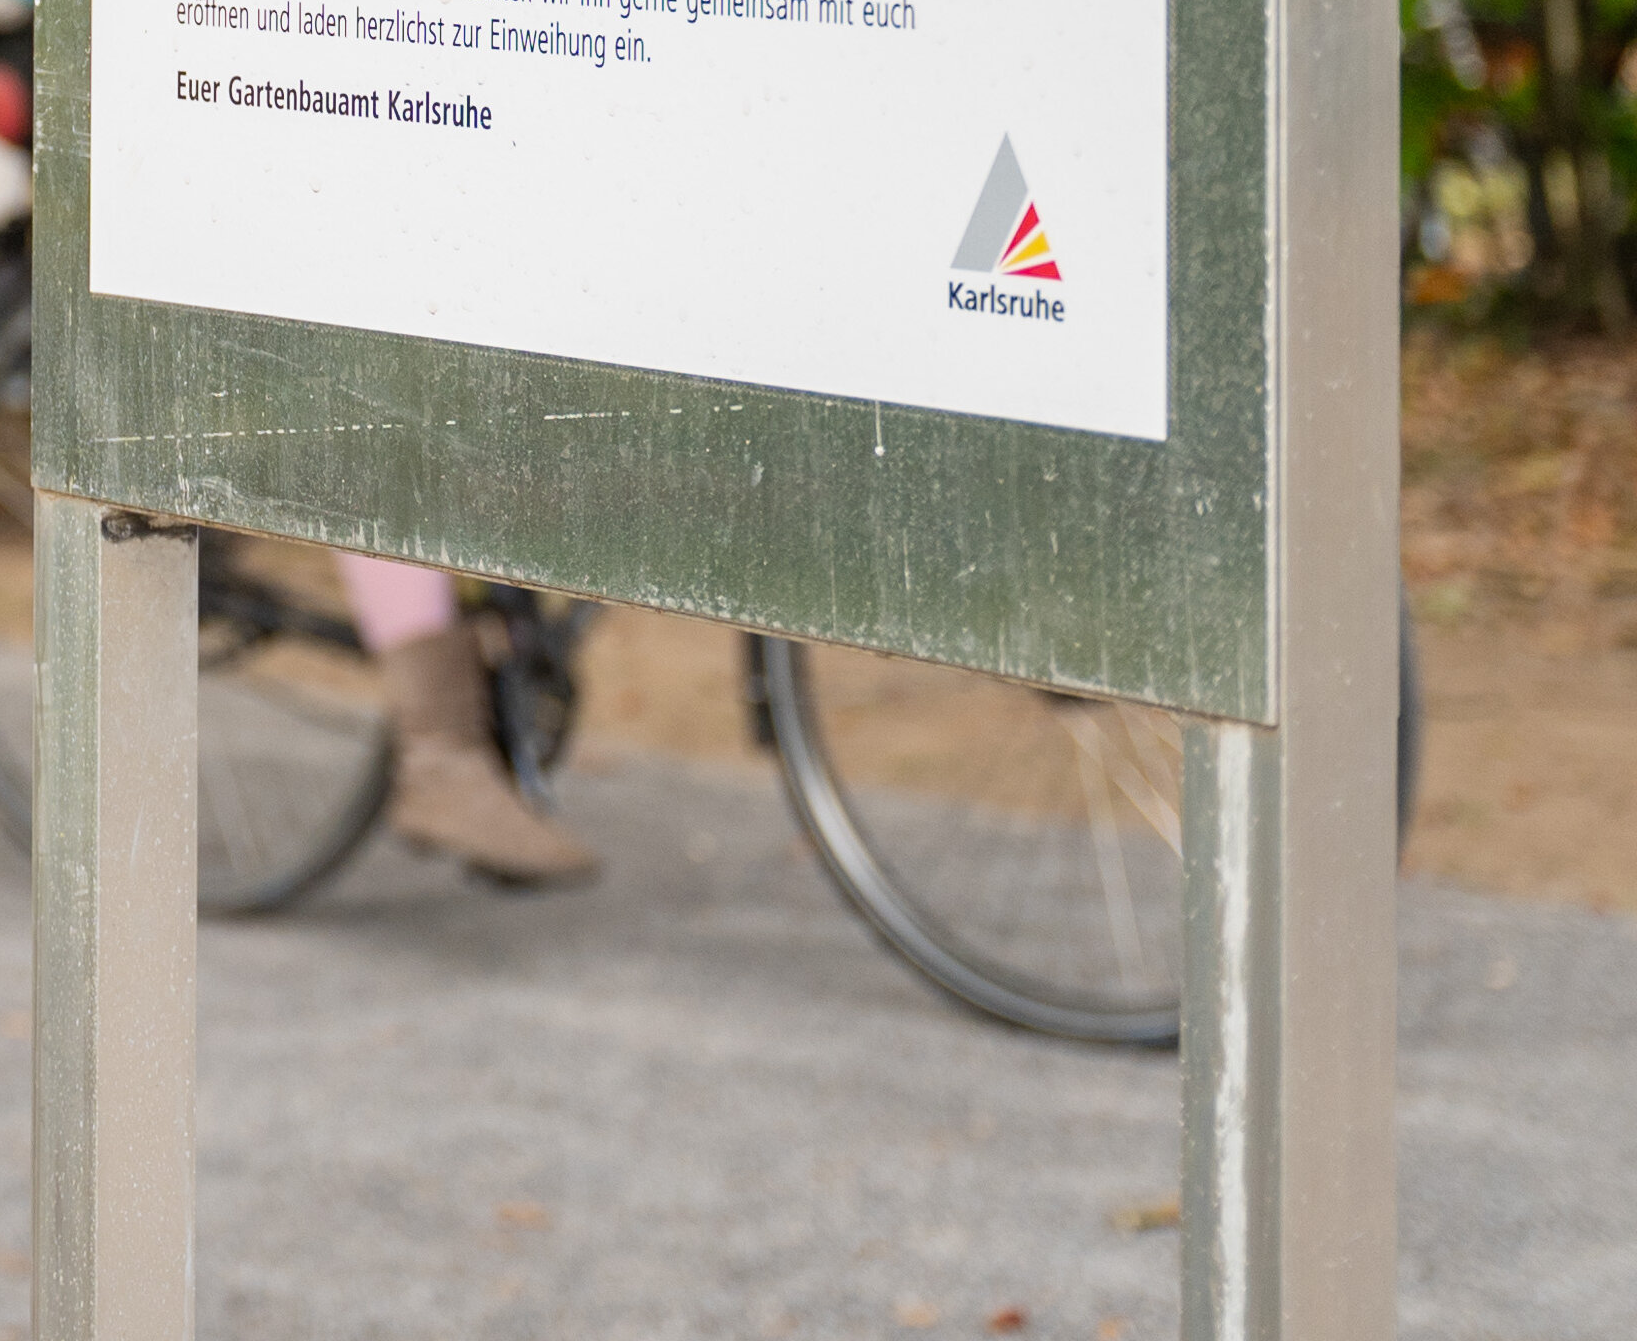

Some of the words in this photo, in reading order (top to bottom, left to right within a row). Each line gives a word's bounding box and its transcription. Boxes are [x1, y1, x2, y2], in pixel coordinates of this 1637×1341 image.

[257, 0, 290, 33] und
[298, 1, 347, 38] laden
[356, 6, 445, 46] herzlichst
[452, 23, 482, 49] zur
[490, 18, 606, 69] Einweihung
[614, 28, 651, 63] ein.
[177, 70, 221, 103] Euer
[228, 75, 380, 120] Gartenbauamt
[388, 89, 492, 130] Karlsruhe
[948, 281, 1065, 323] Karlsruhe
